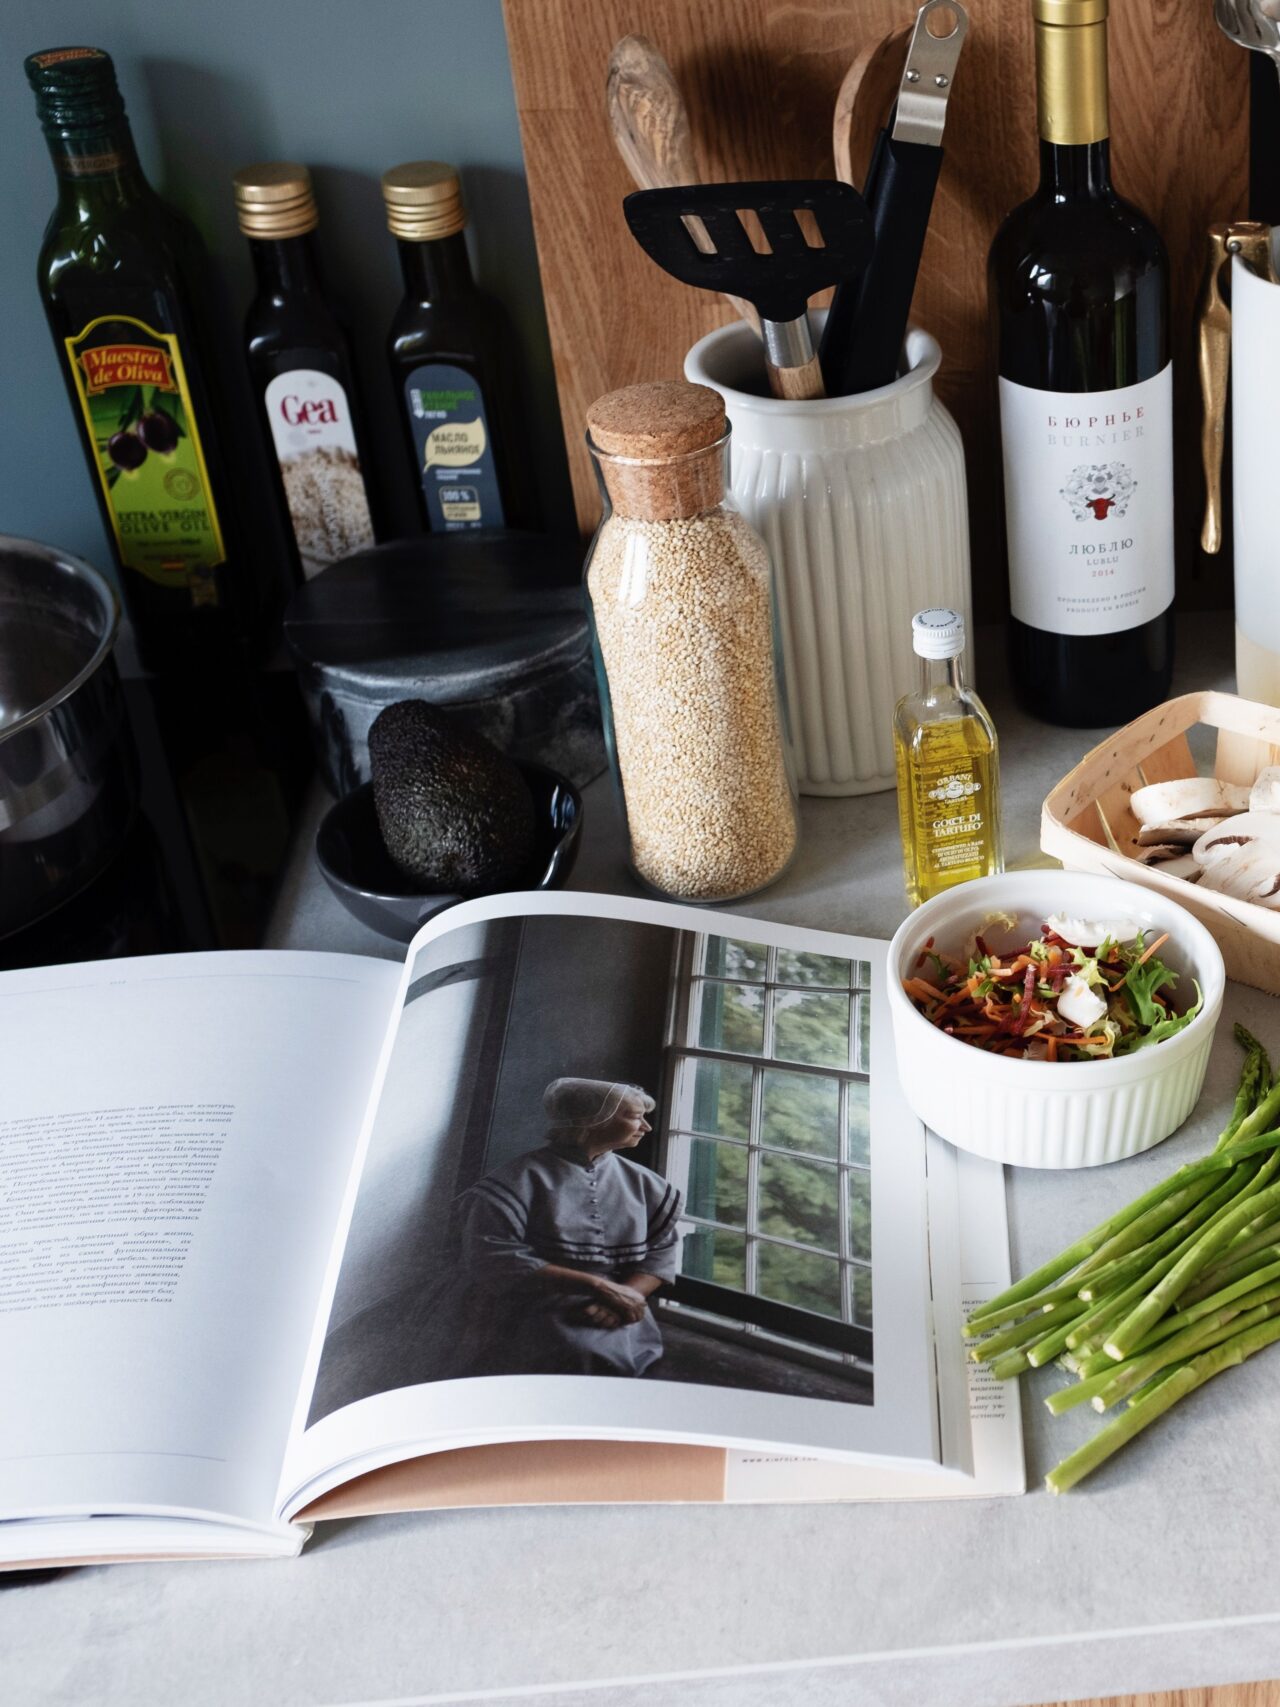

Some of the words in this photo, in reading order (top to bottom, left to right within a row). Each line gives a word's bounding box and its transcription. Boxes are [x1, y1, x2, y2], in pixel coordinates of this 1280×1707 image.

[91, 349, 160, 368] Maestro
[94, 367, 112, 384] de
[117, 364, 163, 382] Oliva
[281, 394, 338, 427] Gea
[1048, 406, 1145, 429] БЮРНЬЕ
[431, 433, 468, 443] МАСЛО
[1047, 425, 1145, 447] BURNIER
[434, 444, 480, 455] ЛЬНЯНОЕ
[117, 511, 155, 522] EXTRA
[157, 509, 207, 521] VIRGIN
[120, 521, 169, 534] OLIVE
[180, 519, 210, 532] OIL
[1069, 538, 1134, 556] ЛЮБЛЮ
[1086, 556, 1119, 566] LUBLU
[1091, 569, 1115, 578] 2014
[969, 813, 981, 822] DI
